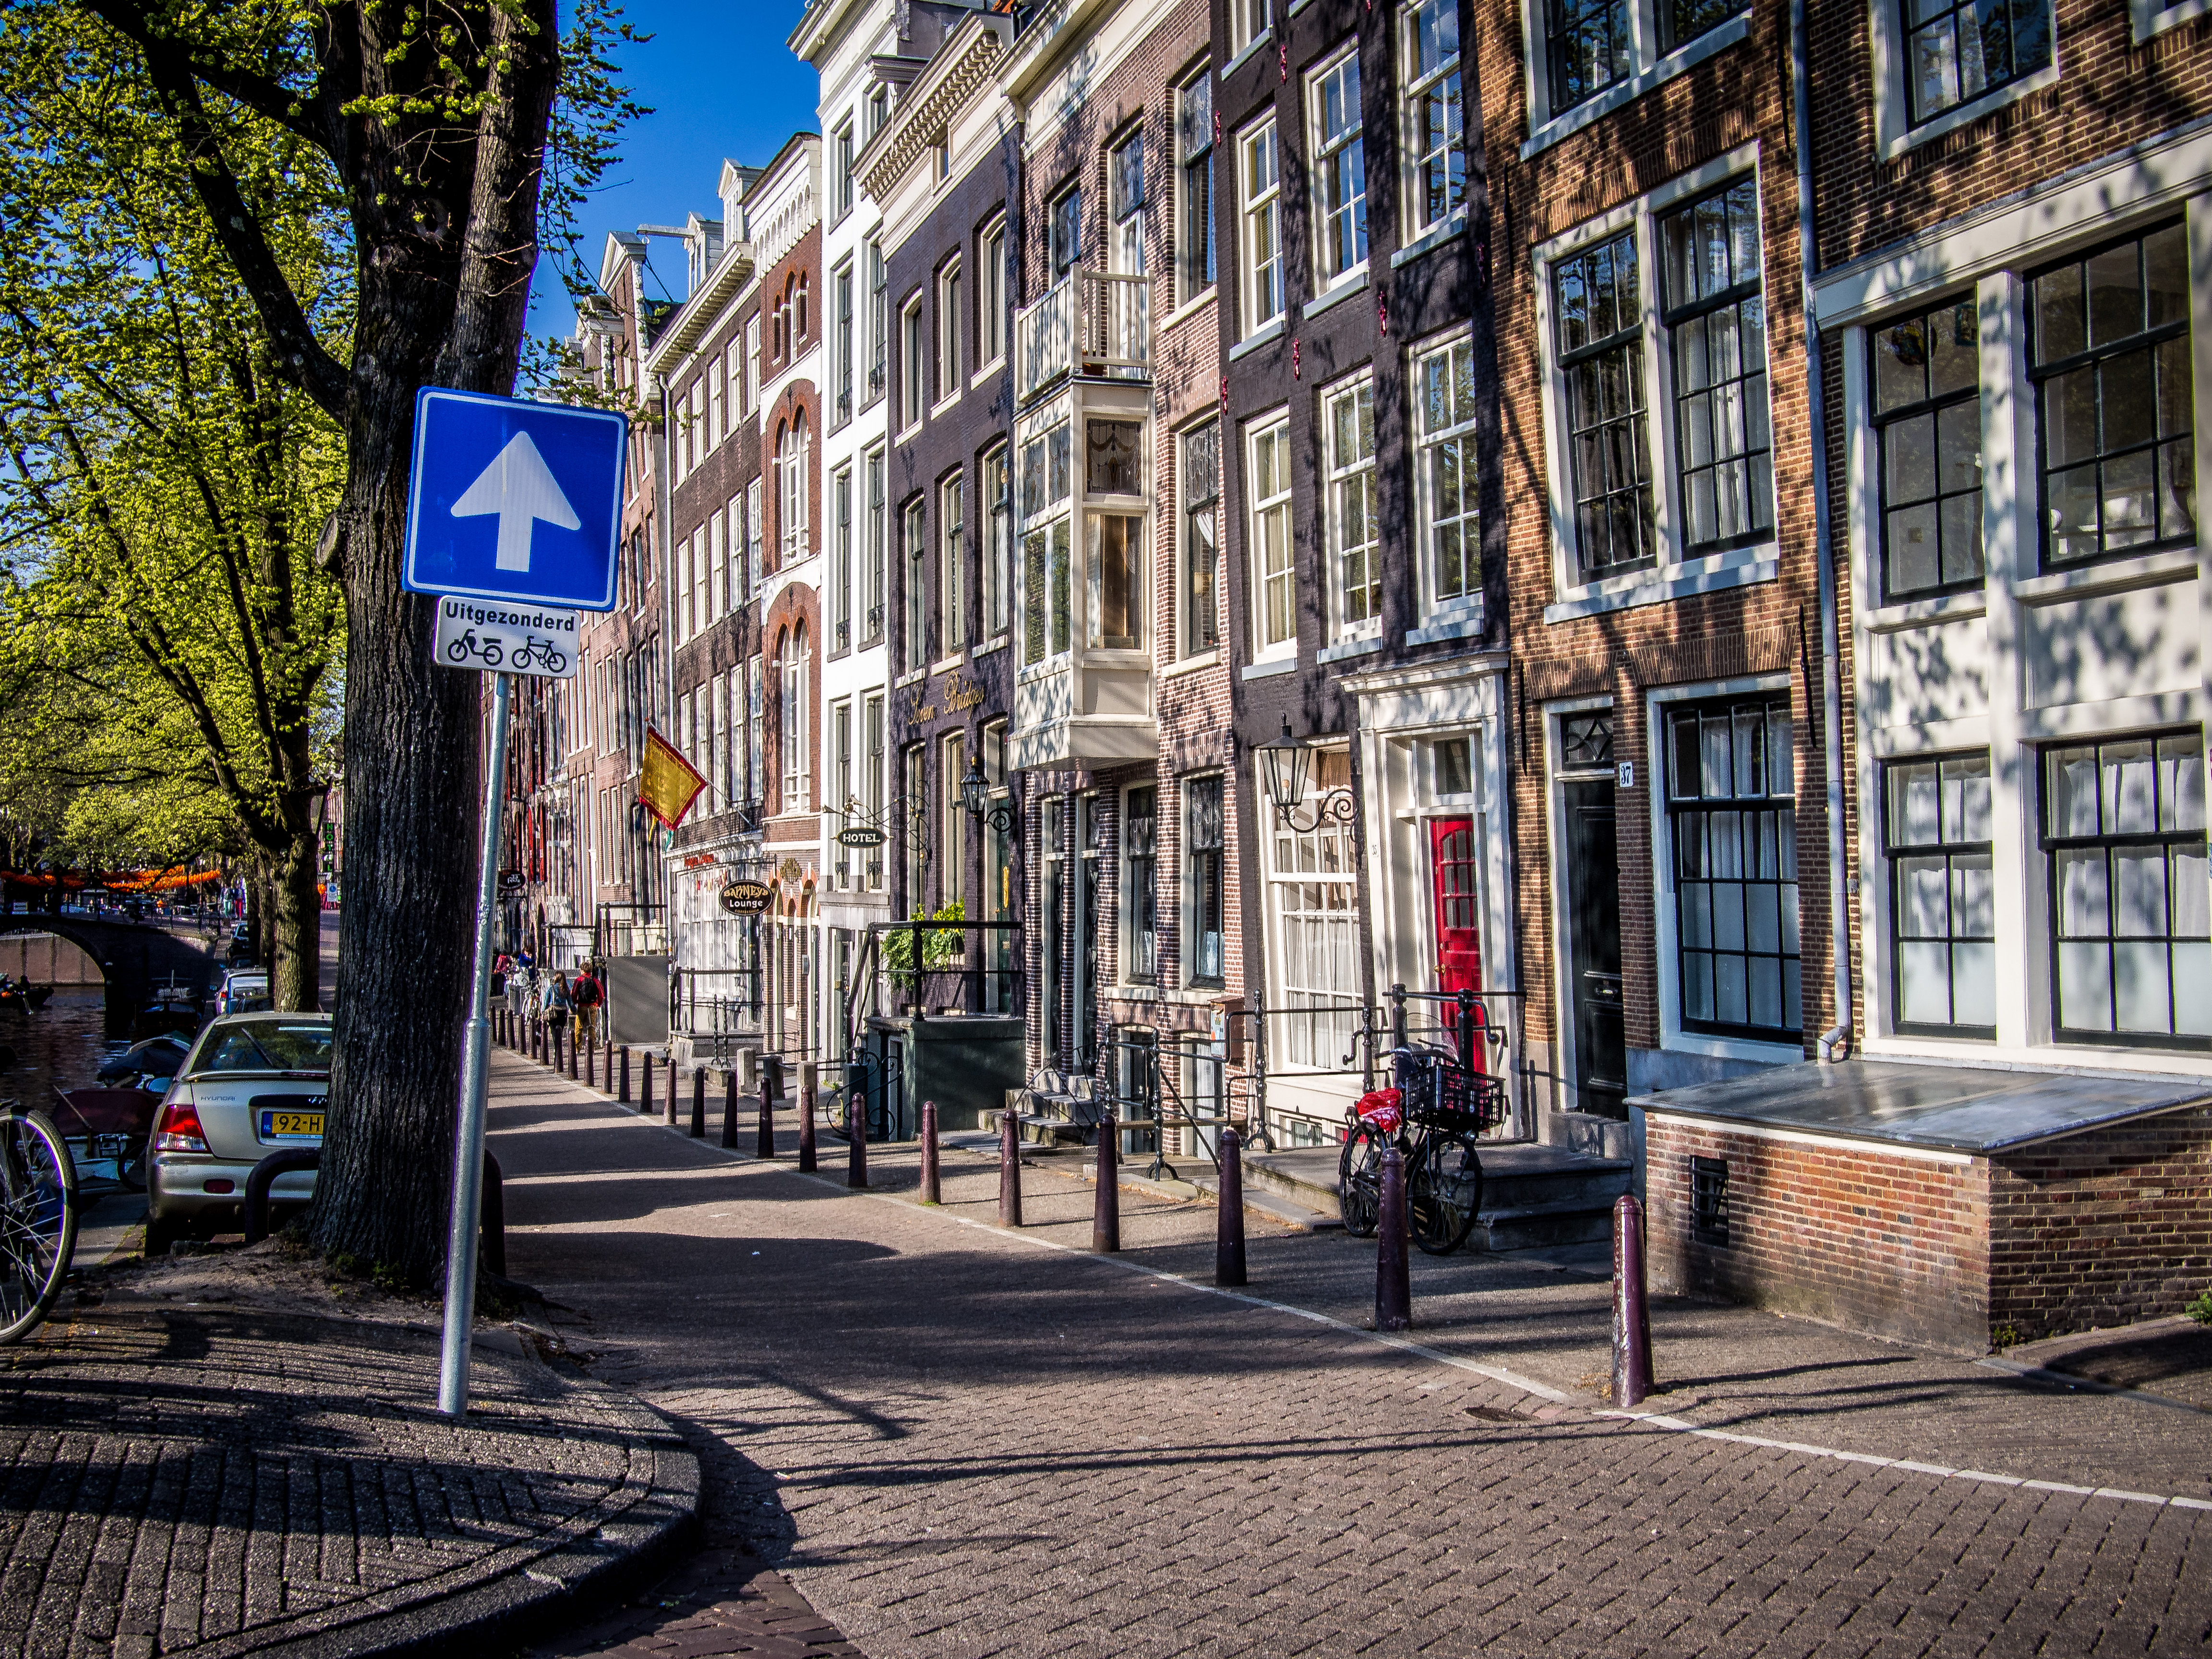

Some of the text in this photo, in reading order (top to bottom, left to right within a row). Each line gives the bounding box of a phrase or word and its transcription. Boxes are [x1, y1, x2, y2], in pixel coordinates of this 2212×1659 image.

[445, 601, 575, 632] Uitgezonderd
[908, 671, 984, 725] Seven Bridges
[1621, 766, 1631, 784] 37
[843, 833, 880, 842] HOTEL
[730, 899, 763, 908] Lounge
